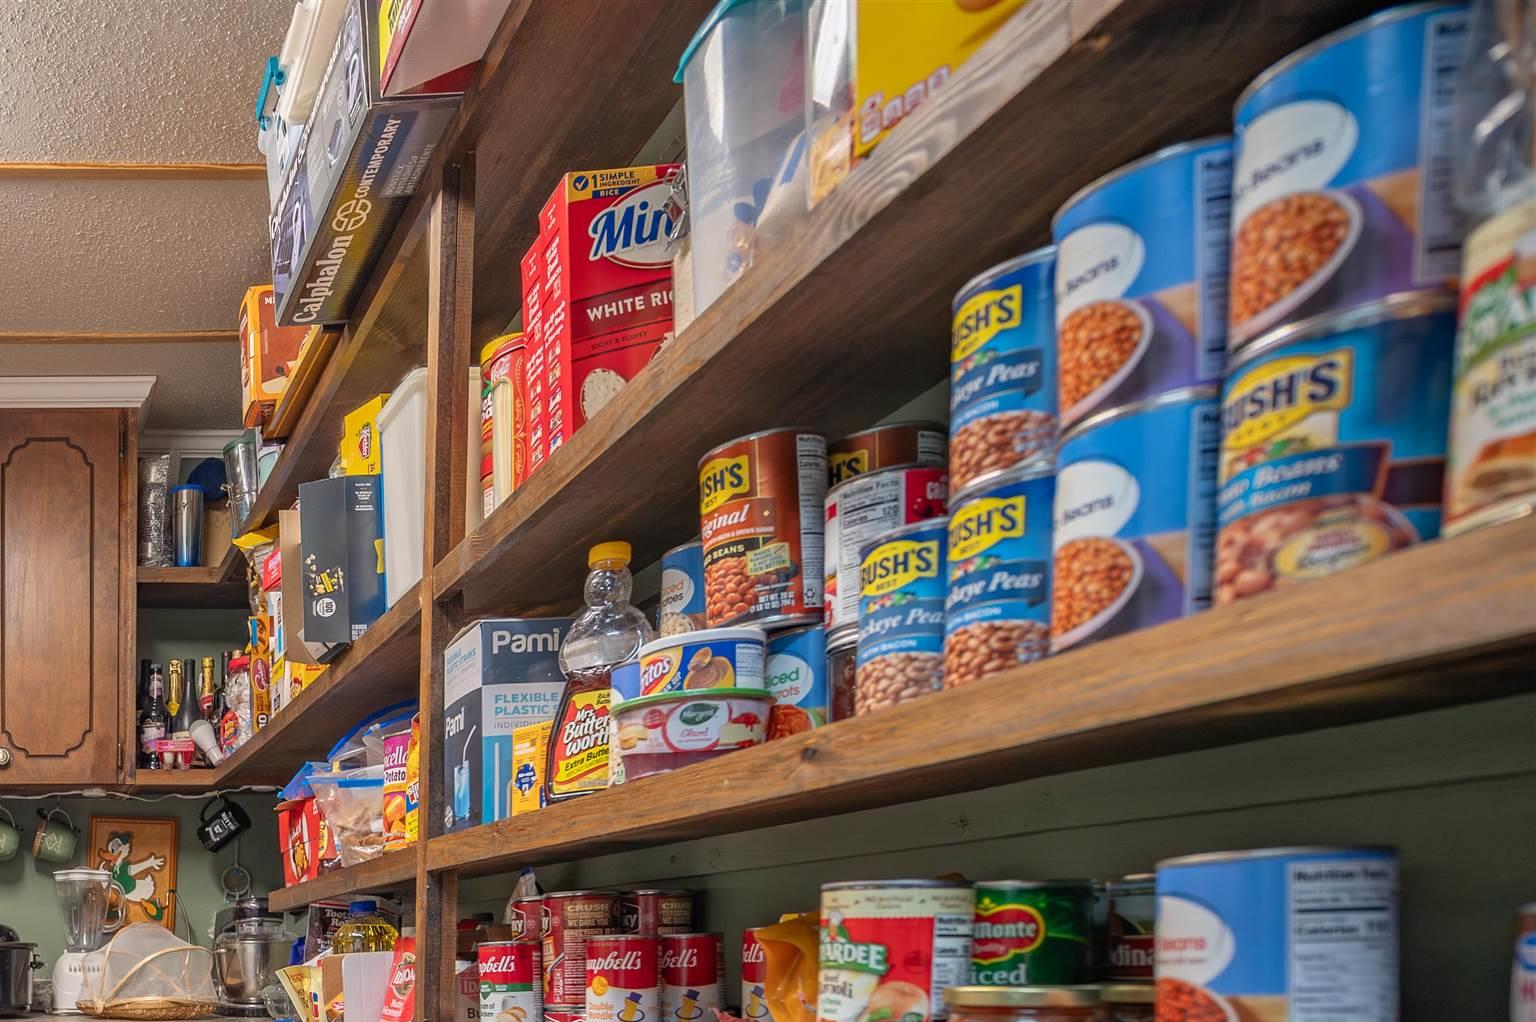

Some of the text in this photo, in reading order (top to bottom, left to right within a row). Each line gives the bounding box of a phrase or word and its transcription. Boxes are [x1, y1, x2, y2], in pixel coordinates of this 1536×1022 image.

[591, 174, 598, 189] 1
[599, 171, 635, 182] SIMPLE
[599, 178, 640, 188] INGREDIENT
[599, 188, 620, 197] RICE
[292, 233, 354, 324] Calphalon
[355, 116, 402, 200] CONTEMPORARY
[587, 293, 645, 323] WHITE
[988, 362, 1039, 388] Peas
[714, 543, 745, 559] BEANS
[989, 571, 1043, 592] Peas
[492, 627, 560, 655] Pami
[494, 692, 559, 704] FLEXIBLE
[494, 705, 549, 717] PLASTIC
[575, 709, 594, 722] Mrs
[444, 705, 465, 740] Pami
[563, 715, 610, 745] Butter
[564, 758, 585, 772] Extra
[566, 904, 609, 912] CRUSH
[974, 920, 1036, 941] Monte
